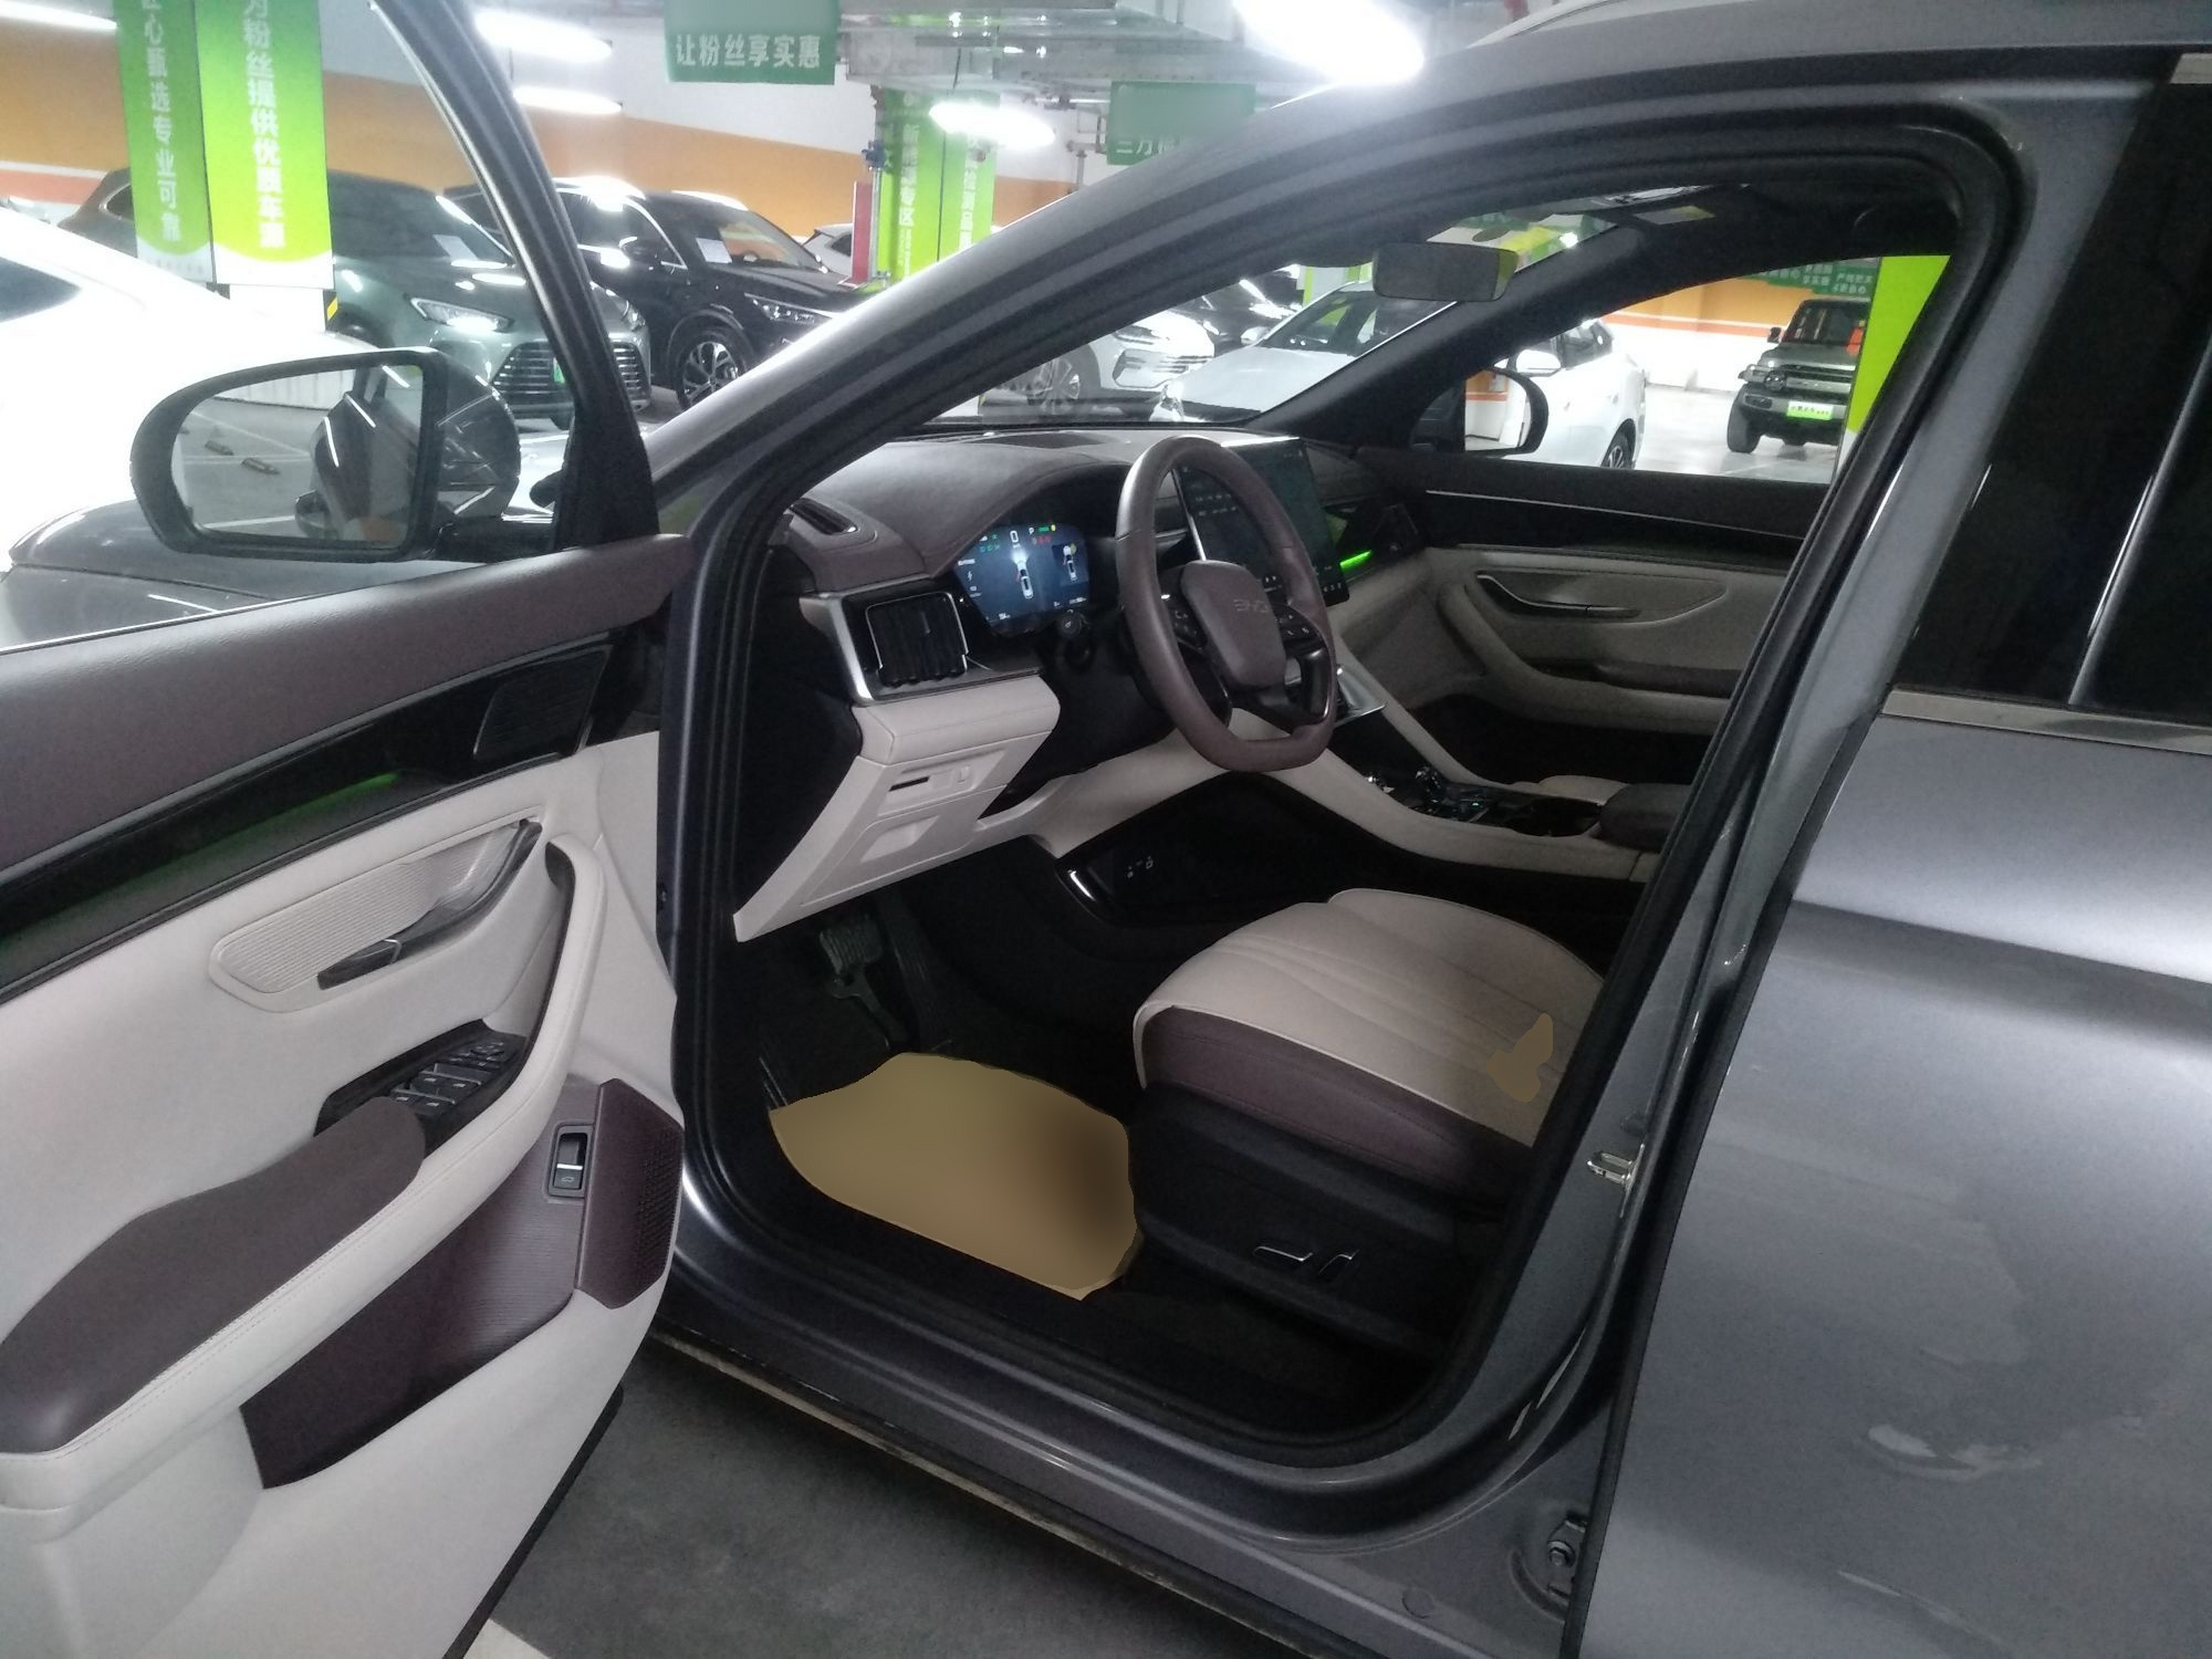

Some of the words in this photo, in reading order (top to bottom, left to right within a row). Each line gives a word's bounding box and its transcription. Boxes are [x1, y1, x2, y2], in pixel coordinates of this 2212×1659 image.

[676, 33, 820, 69] 让粉丝享实惠
